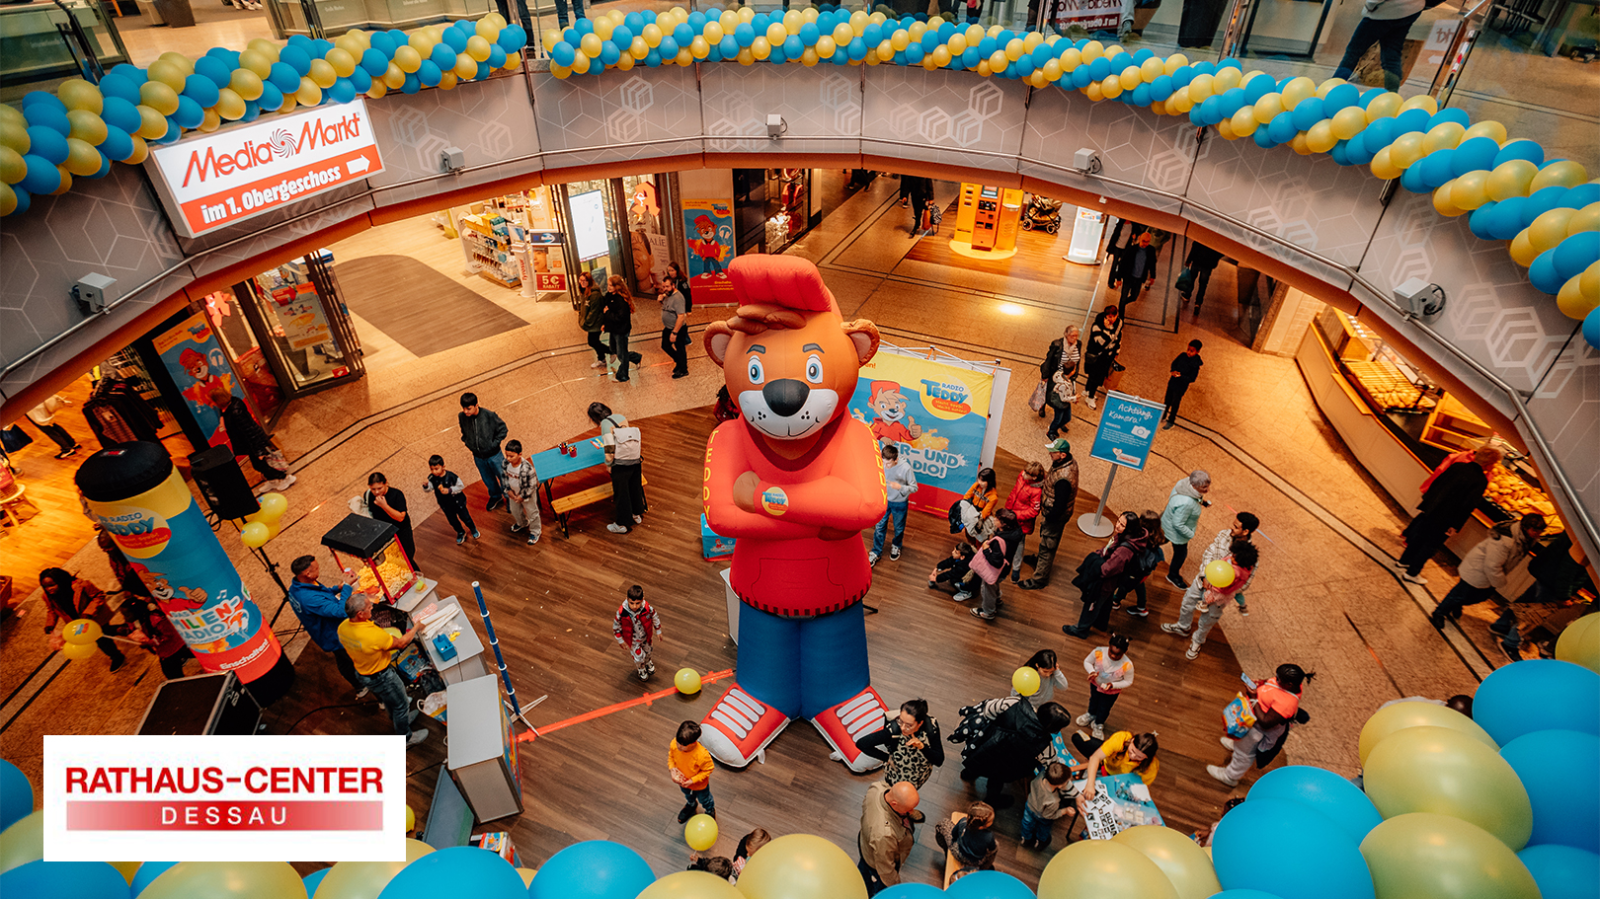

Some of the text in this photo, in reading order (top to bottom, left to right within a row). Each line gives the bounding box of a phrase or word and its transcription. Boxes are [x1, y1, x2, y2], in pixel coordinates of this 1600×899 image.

[182, 112, 360, 188] Media Markt
[201, 166, 342, 224] im 1. Obergeschoss
[920, 378, 968, 404] TEDDY
[941, 382, 965, 393] RADIO
[1108, 411, 1142, 423] Kamera!
[1117, 403, 1153, 420] Achtung,
[924, 448, 959, 468] UND
[703, 430, 719, 520] TEDDY
[219, 638, 269, 670] Einschalten!
